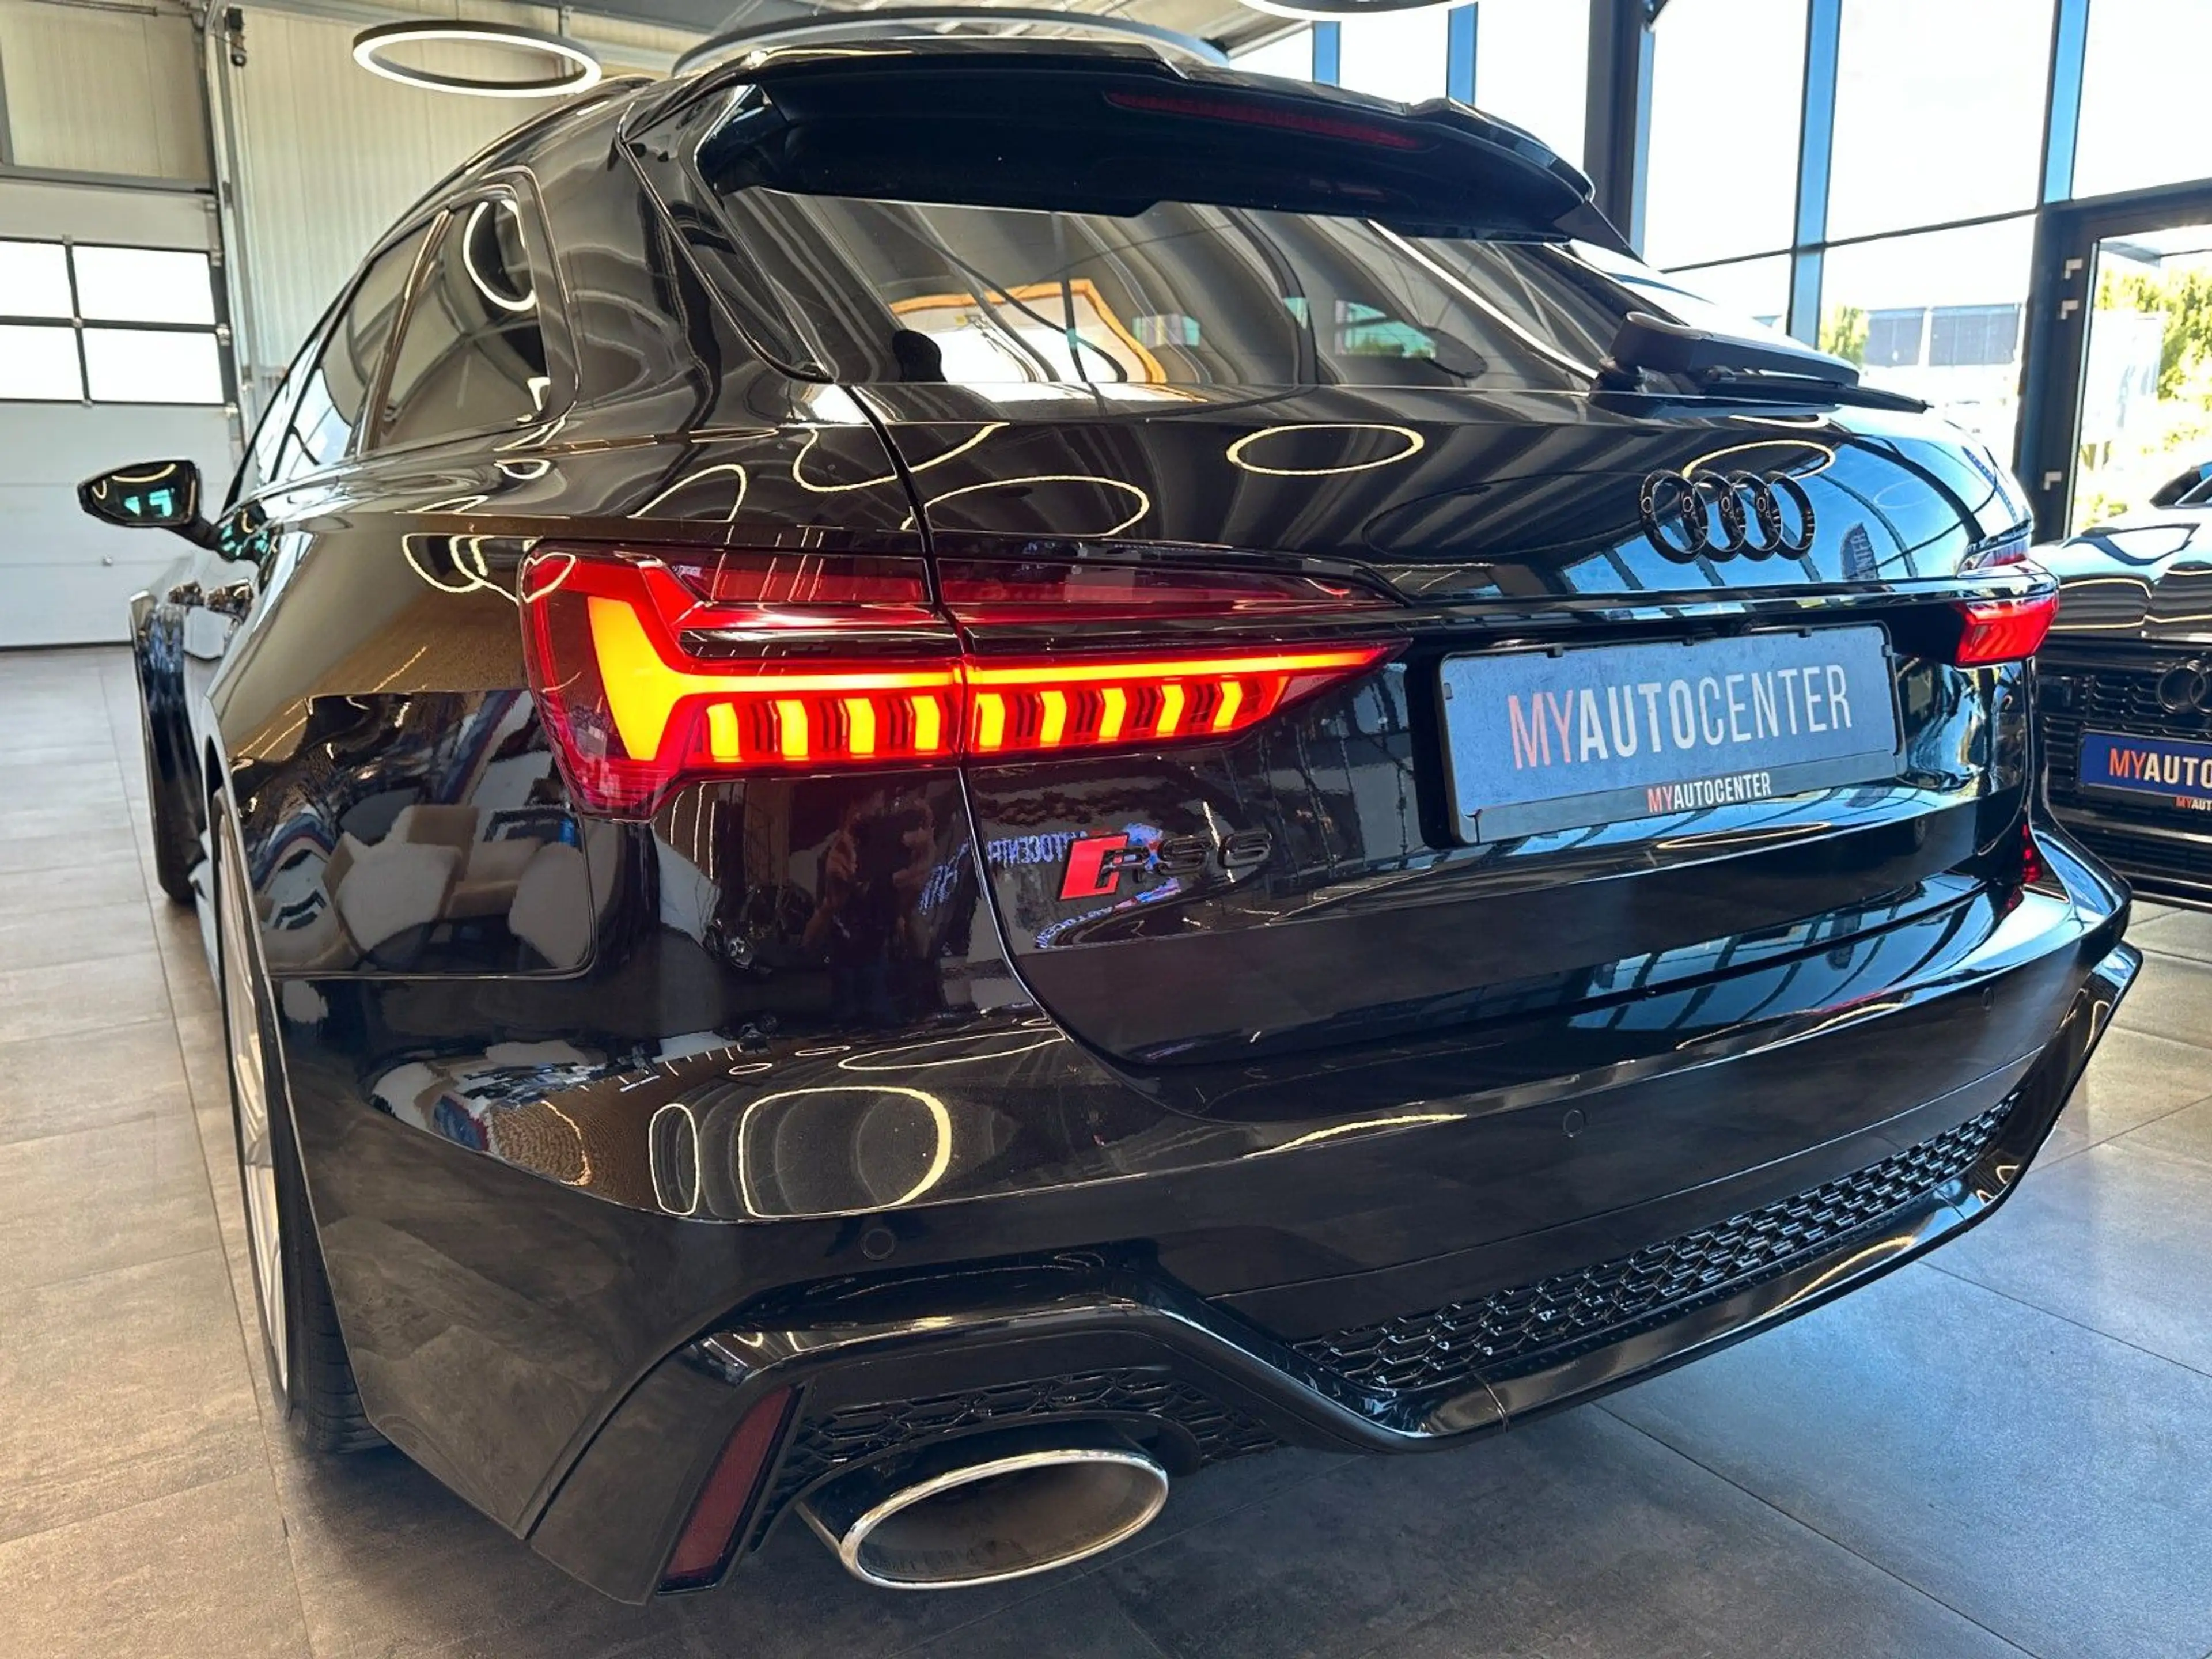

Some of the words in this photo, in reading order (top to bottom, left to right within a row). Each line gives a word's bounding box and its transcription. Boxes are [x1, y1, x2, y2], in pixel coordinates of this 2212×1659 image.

[1507, 664, 1852, 770] MYAUTOCENTER
[2108, 747, 2212, 789] MYAUTO
[1647, 771, 1772, 813] MYAUTOCENTER
